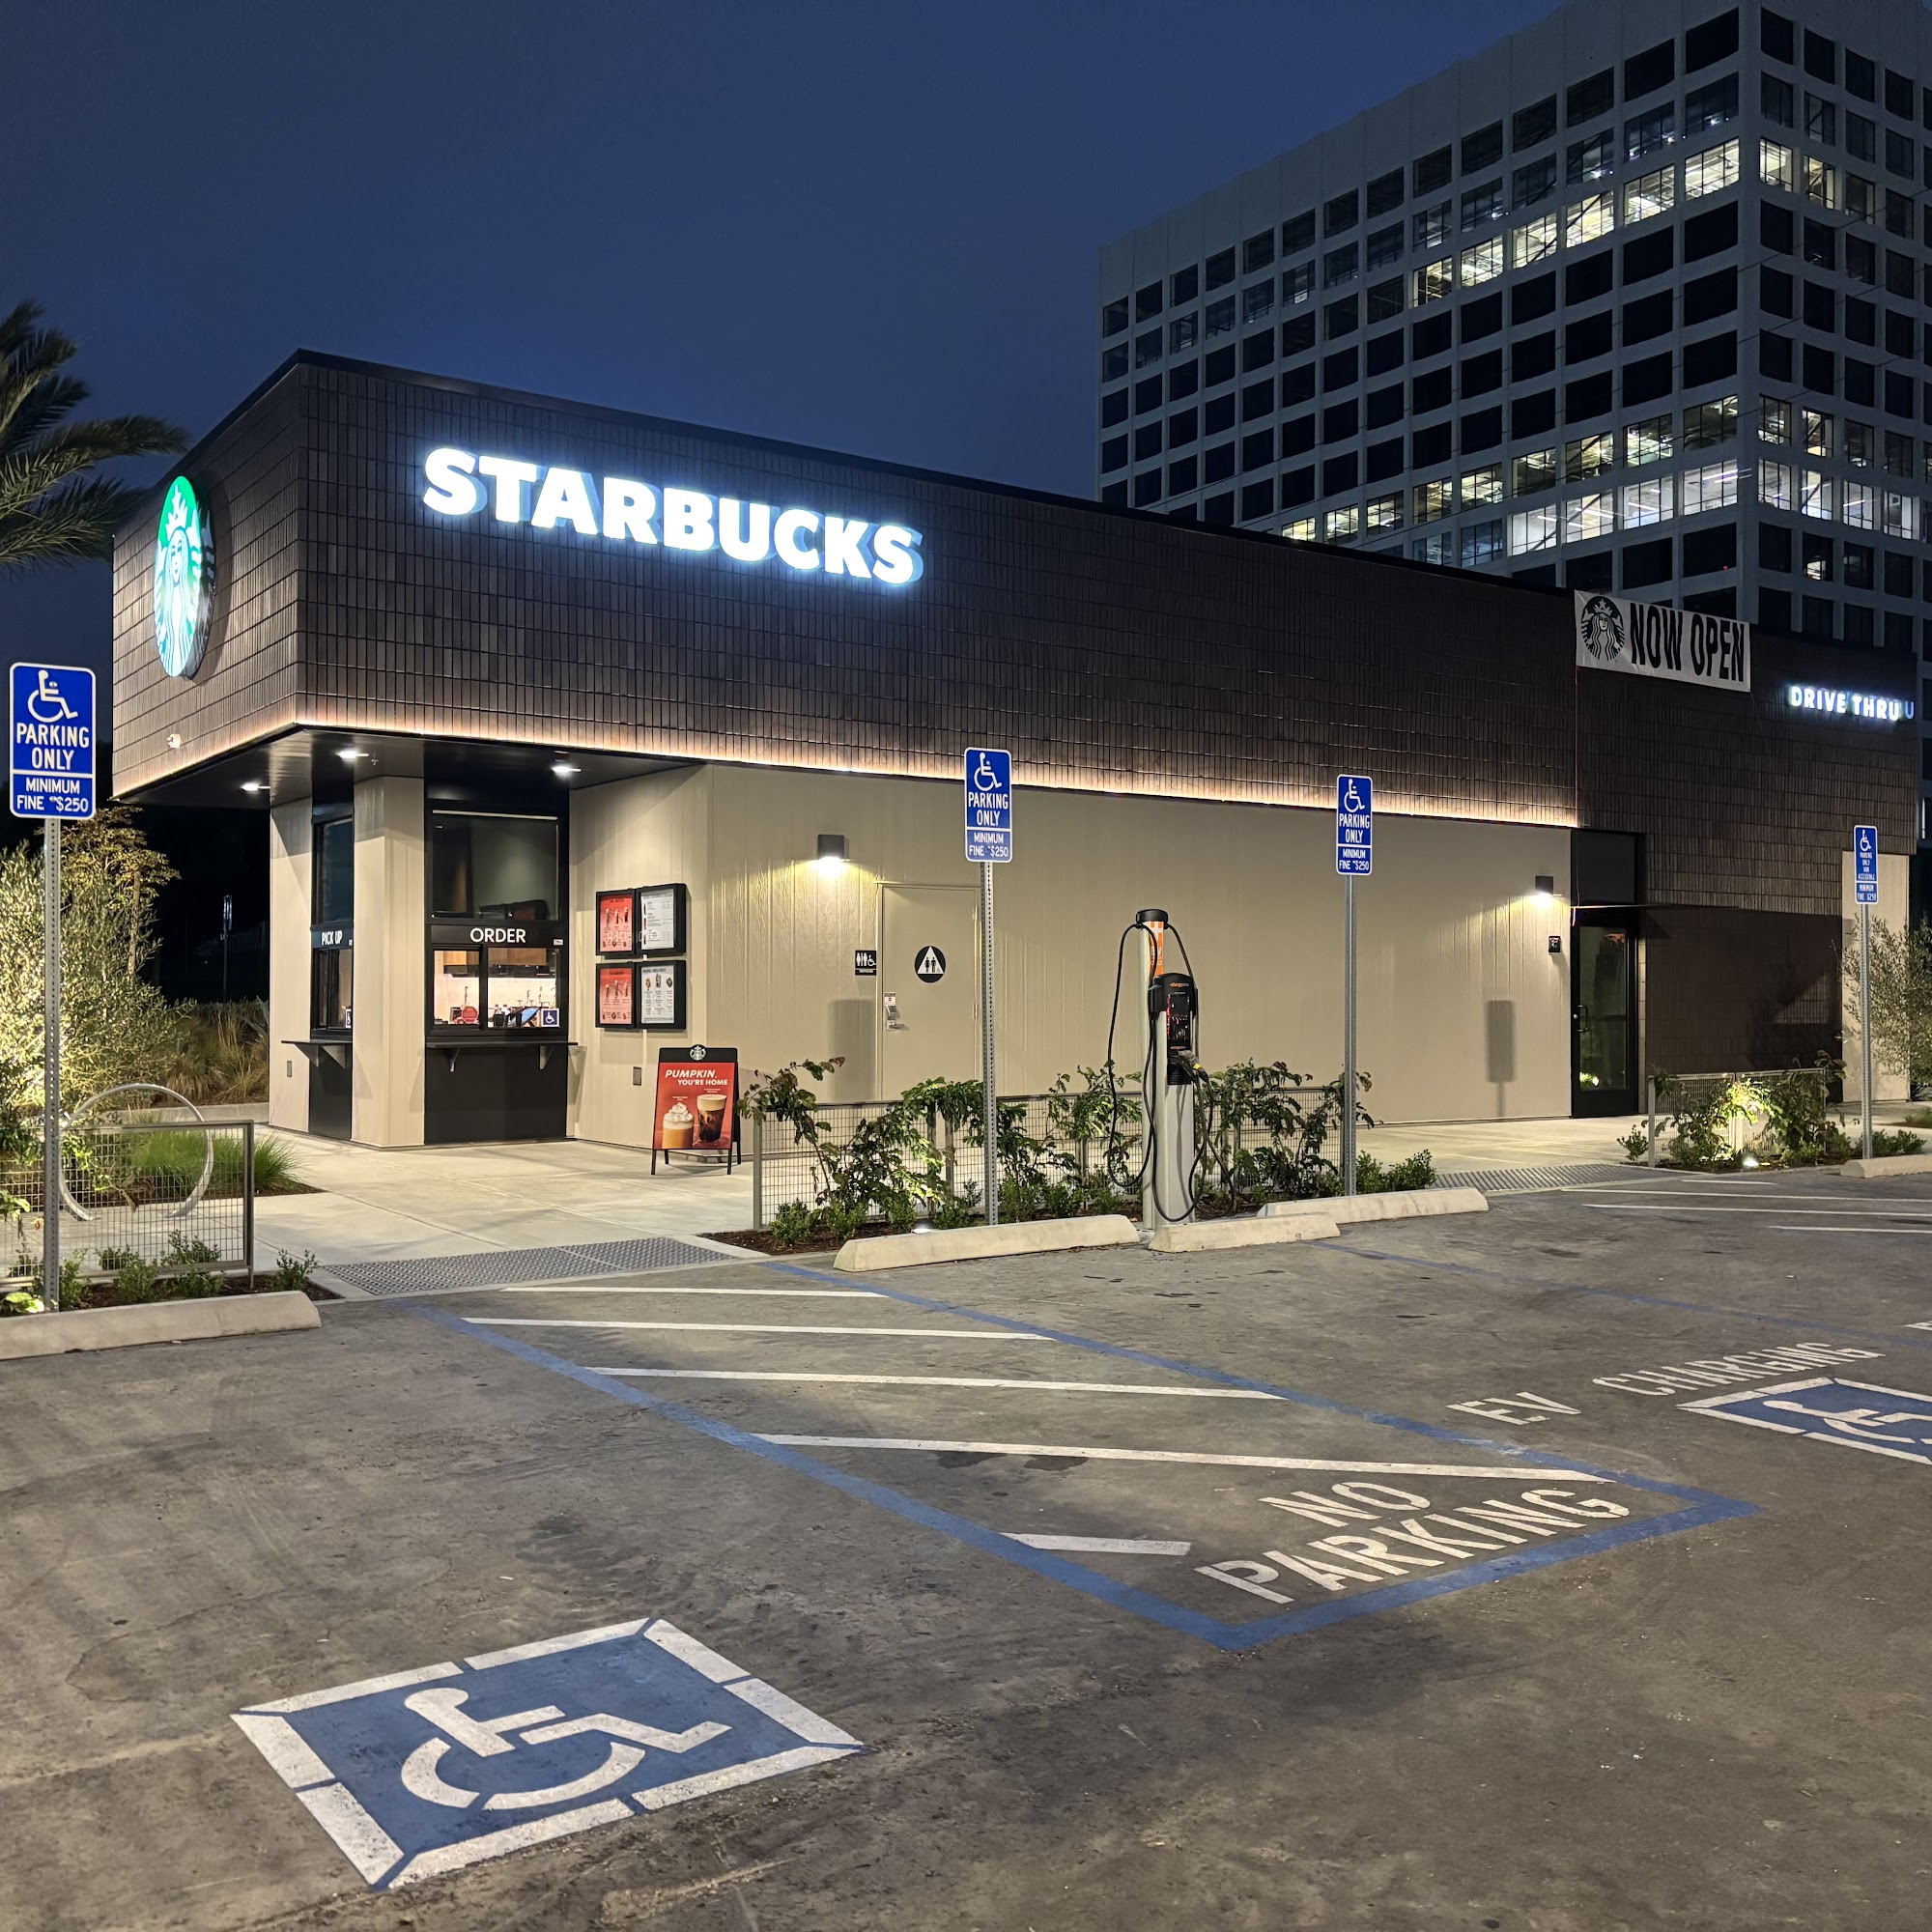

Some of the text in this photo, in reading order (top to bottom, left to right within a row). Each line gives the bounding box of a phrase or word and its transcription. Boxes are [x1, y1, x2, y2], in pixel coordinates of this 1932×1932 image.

[422, 447, 923, 585] STARBUCKS
[1630, 602, 1746, 683] NOW OPEN
[1791, 685, 1900, 722] DRIVE THRU
[16, 723, 90, 749] PARKING
[31, 748, 74, 771] ONLY
[25, 777, 80, 795] MINIMUM
[16, 795, 89, 813] FINE $250
[968, 792, 1009, 810] PARKING
[976, 810, 1001, 827] ONLY
[1339, 813, 1370, 829] PARKING
[974, 832, 1005, 844] MINIMUM
[1345, 829, 1364, 843] ONLY
[969, 845, 1009, 858] FINE $250
[1342, 848, 1366, 859] MINIMUM
[1339, 860, 1370, 871] FINE $250
[321, 930, 343, 946] PICK UP
[469, 927, 526, 944] ORDER
[665, 1069, 718, 1079] PUMPKIN,
[1446, 1342, 1886, 1425] EV CHARGING
[1258, 1481, 1431, 1527] NO
[1193, 1489, 1630, 1604] PARKING
